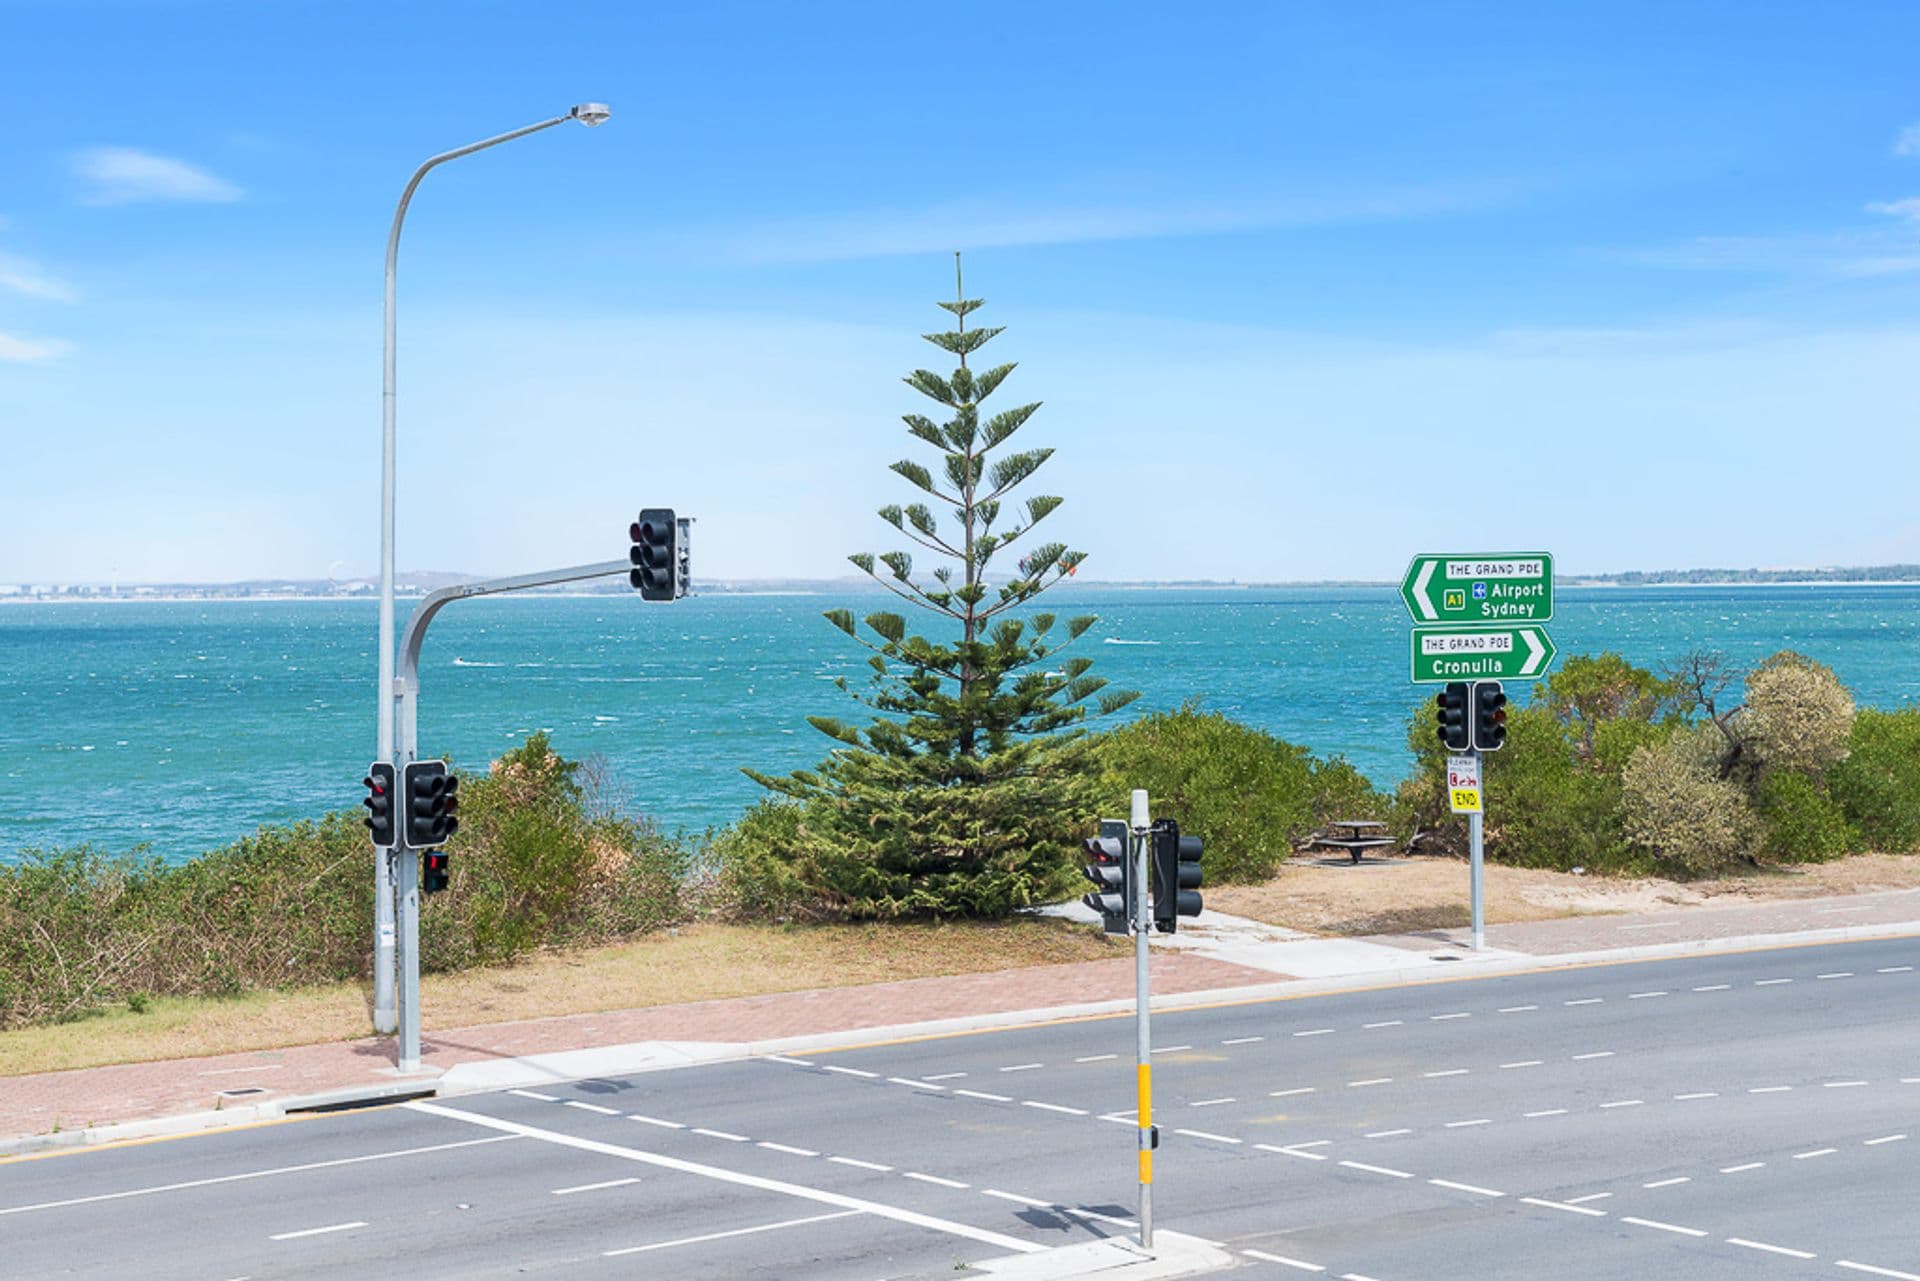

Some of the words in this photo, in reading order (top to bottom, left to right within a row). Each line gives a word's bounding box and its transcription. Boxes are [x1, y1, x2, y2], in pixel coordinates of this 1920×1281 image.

[1450, 565, 1472, 575] THE
[1476, 564, 1514, 575] GRAND
[1519, 563, 1540, 574] PDE
[1491, 583, 1544, 599] Airport
[1447, 594, 1462, 605] A1
[1481, 602, 1535, 618] Sydney
[1426, 639, 1445, 650] THE
[1449, 638, 1485, 650] GRAND
[1490, 637, 1509, 648] PDE
[1433, 658, 1503, 675] Cronulla
[1456, 792, 1477, 806] END
